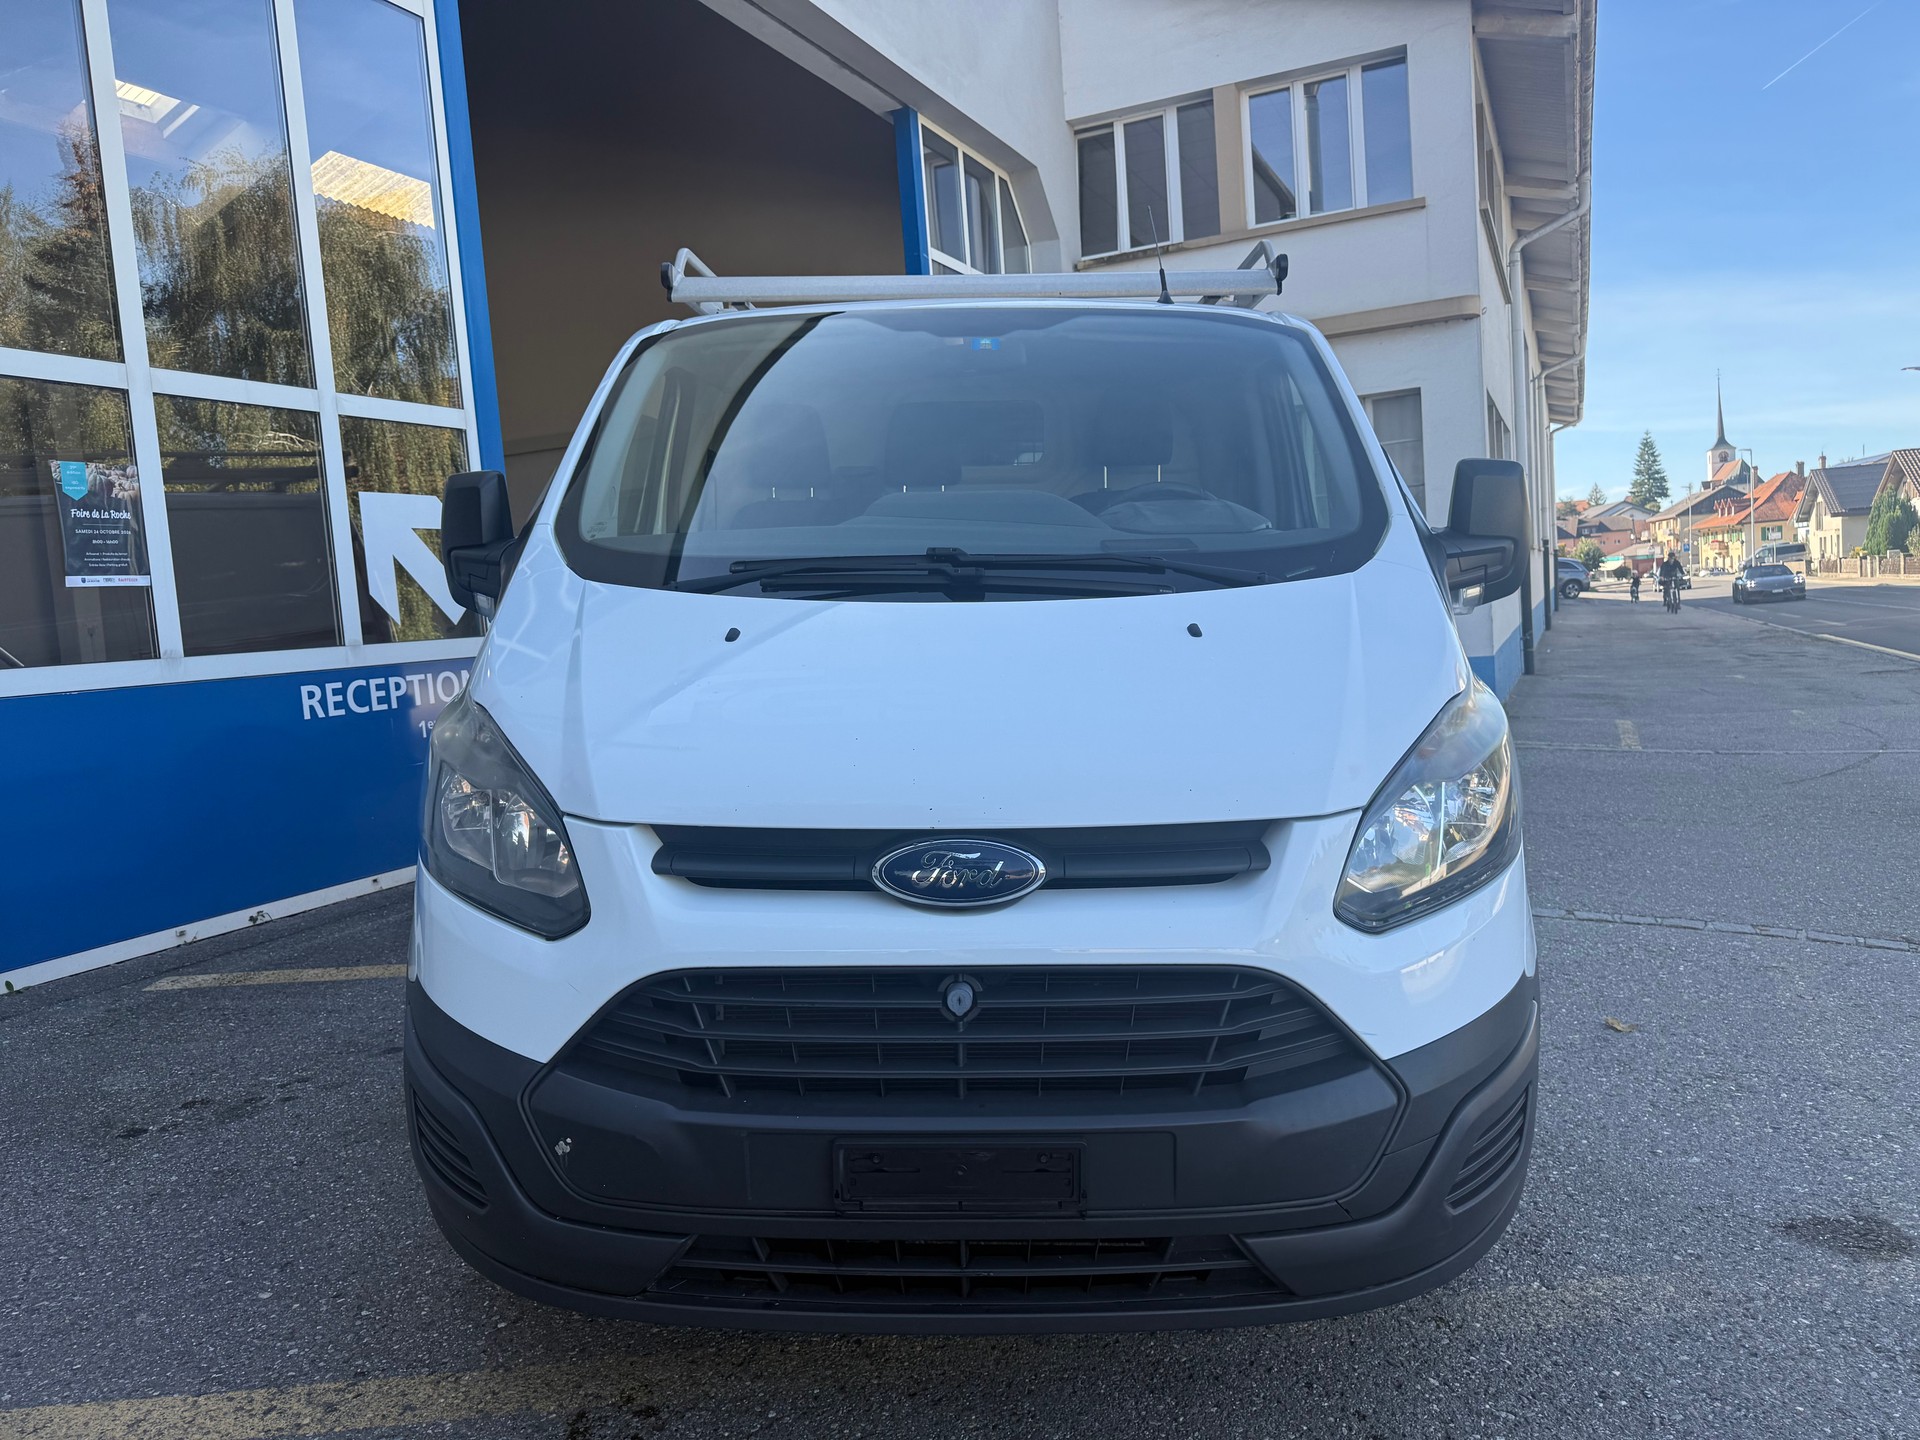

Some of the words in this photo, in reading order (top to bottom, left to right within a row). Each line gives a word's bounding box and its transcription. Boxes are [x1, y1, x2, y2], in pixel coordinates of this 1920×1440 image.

[70, 509, 91, 518] Foire
[92, 509, 100, 518] de
[101, 510, 110, 519] La
[110, 509, 131, 519] Roche
[419, 720, 437, 738] 1e
[912, 850, 1004, 888] Ford
